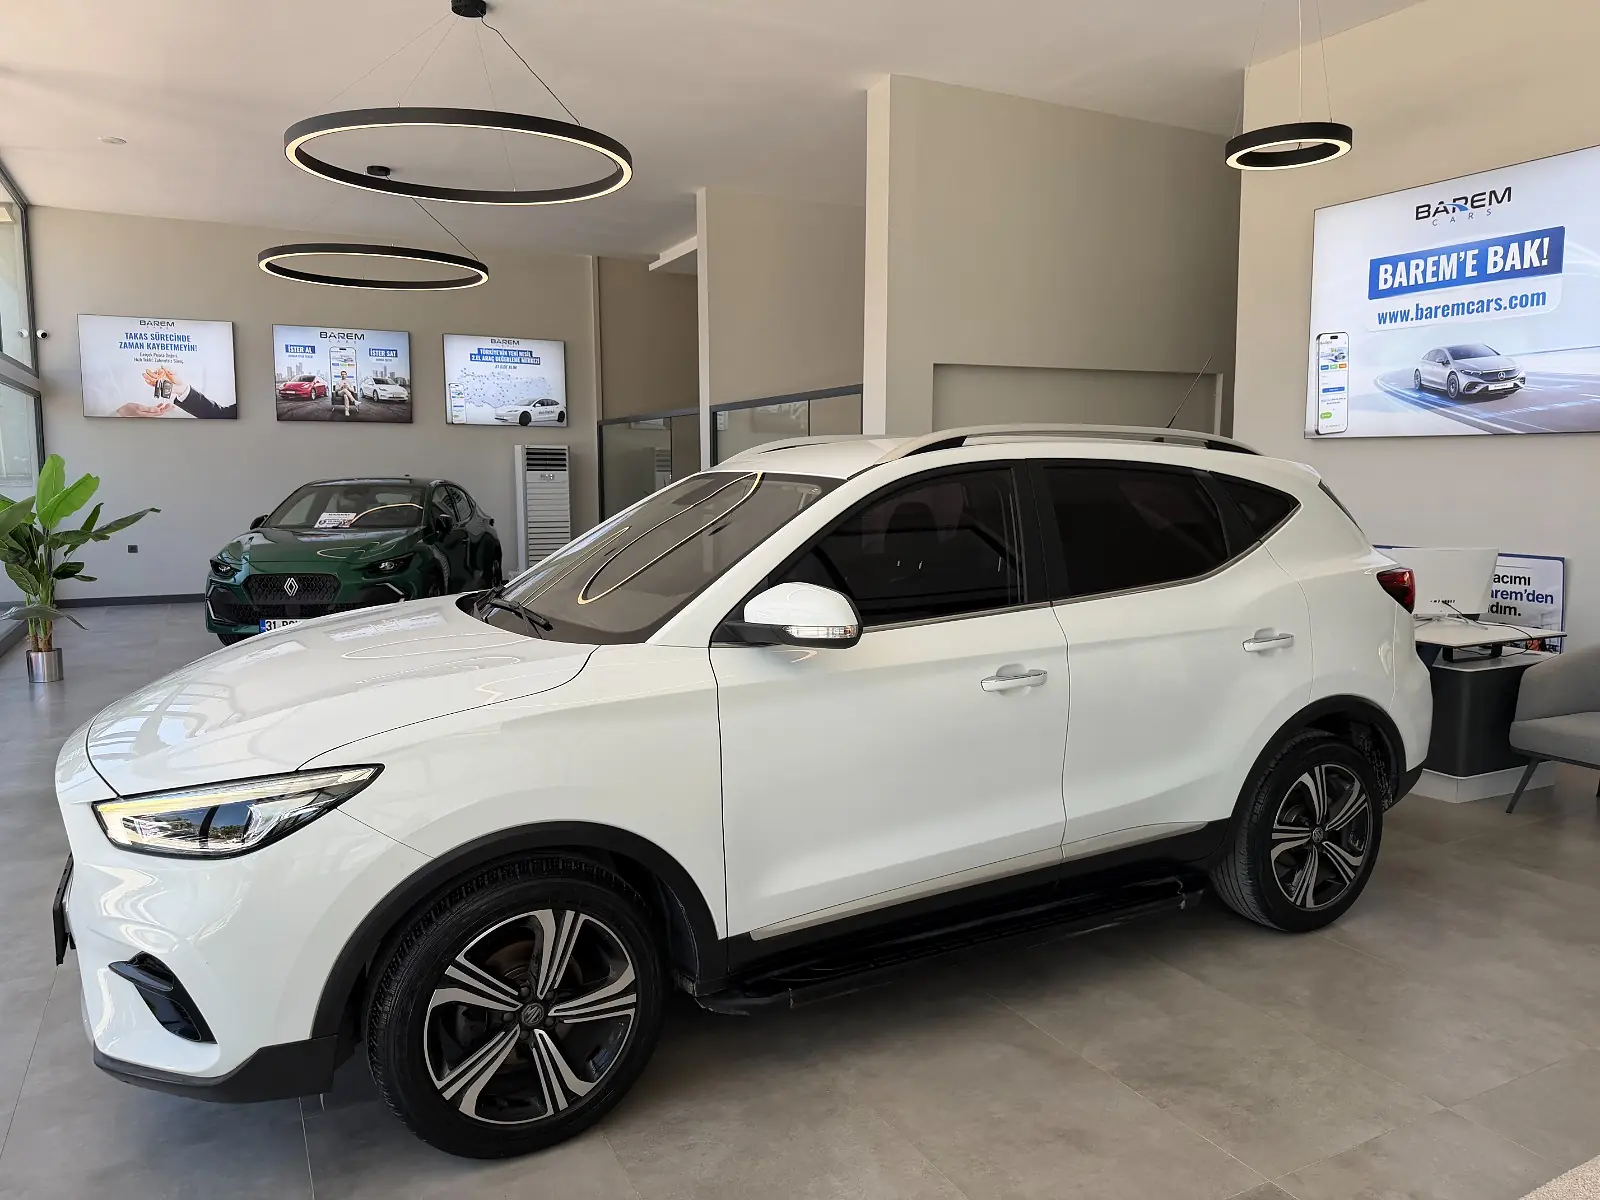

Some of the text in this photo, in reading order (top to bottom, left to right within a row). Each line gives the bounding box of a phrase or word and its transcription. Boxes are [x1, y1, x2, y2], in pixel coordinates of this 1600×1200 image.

[1415, 186, 1512, 220] BAREM
[1432, 209, 1492, 226] CARS
[1486, 237, 1550, 275] BAK!
[1377, 291, 1547, 325] www.baremcars.com
[139, 319, 175, 327] BAREM
[125, 331, 191, 342] TAKAS SÜRECİNDE
[319, 331, 365, 340] BAREM
[119, 341, 198, 352] ZAMAN KAYBETMEYİN!
[490, 338, 520, 346] BAREM
[1487, 602, 1522, 617] dım.
[265, 620, 277, 631] 31
